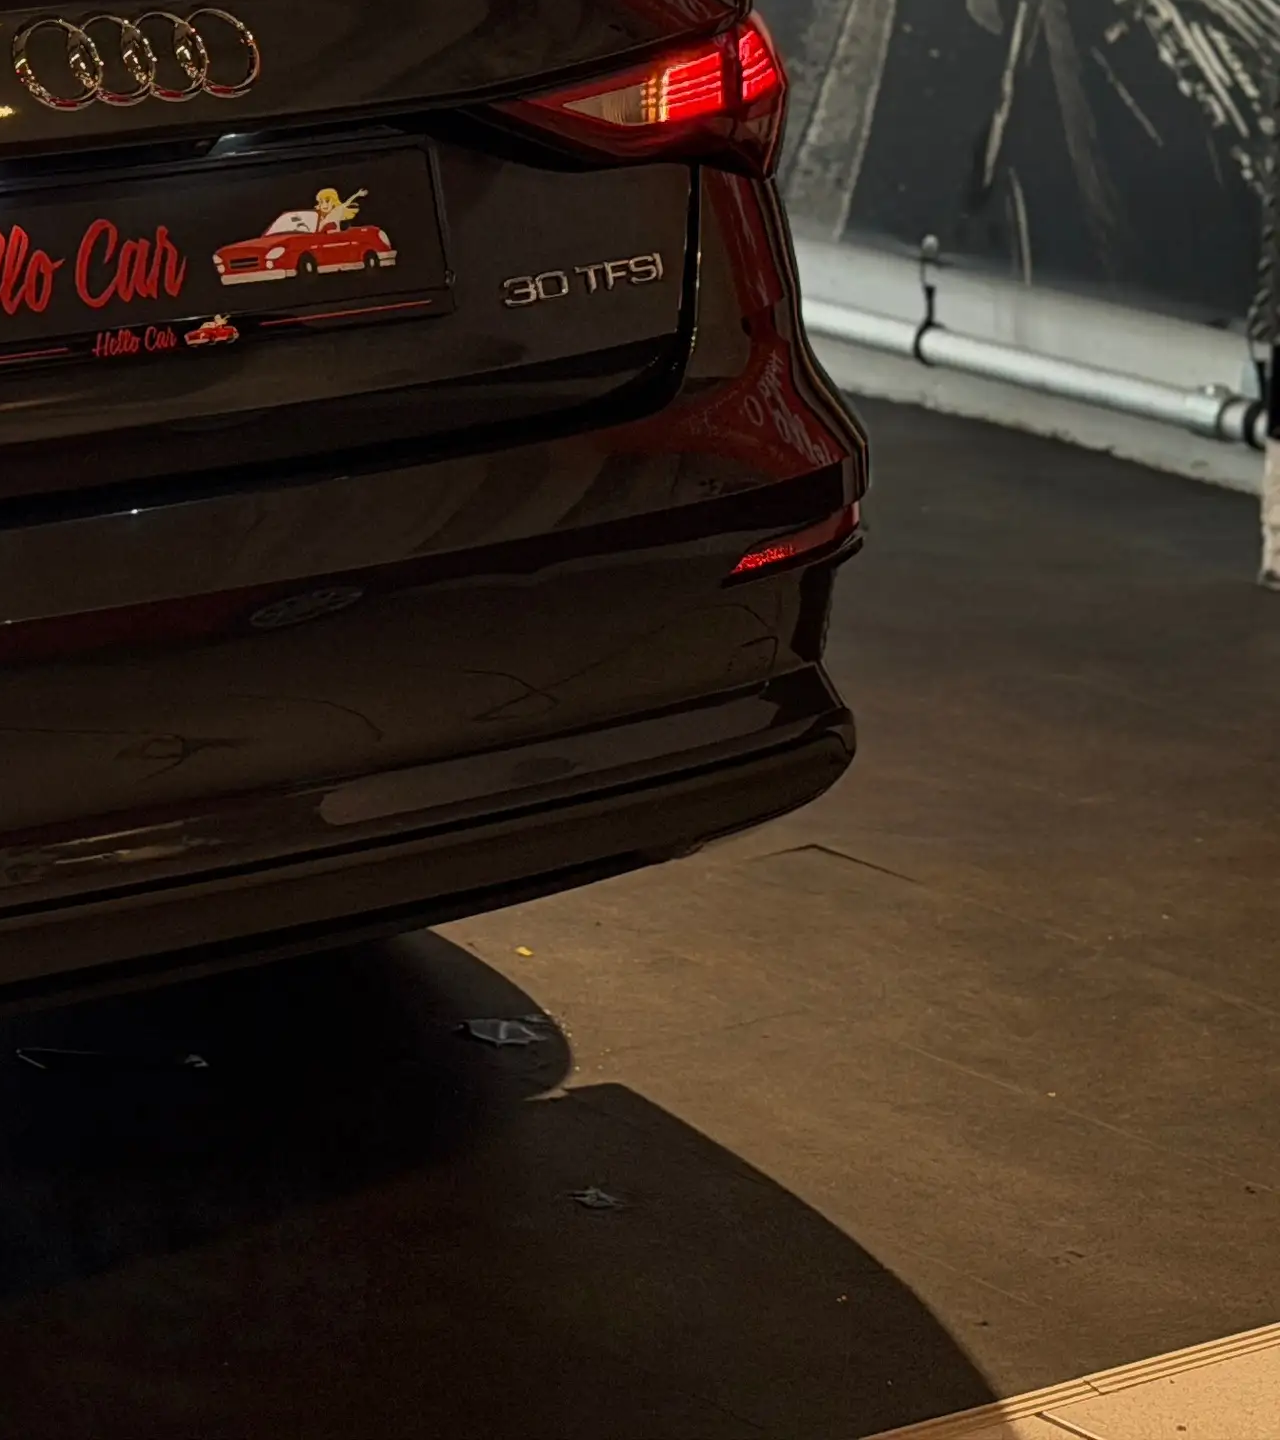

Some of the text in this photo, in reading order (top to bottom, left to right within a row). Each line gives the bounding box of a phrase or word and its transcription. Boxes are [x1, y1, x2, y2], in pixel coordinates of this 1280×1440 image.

[75, 218, 187, 309] Car
[503, 251, 665, 308] 30 TFSI
[91, 324, 178, 358] Hello Car
